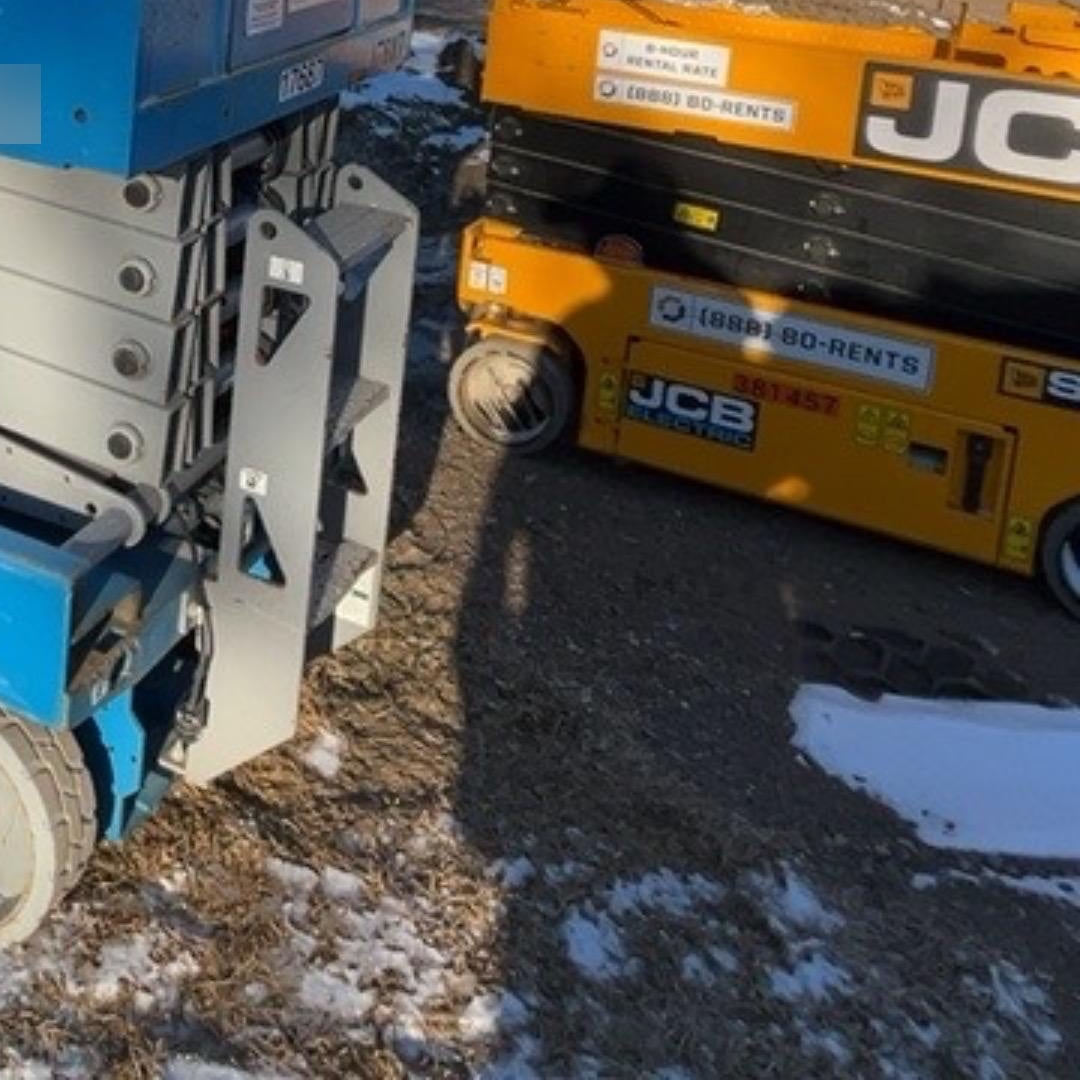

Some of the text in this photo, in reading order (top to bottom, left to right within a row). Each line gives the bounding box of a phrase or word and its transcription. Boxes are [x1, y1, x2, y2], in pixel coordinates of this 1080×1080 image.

[699, 307, 920, 376] (888) 80-RENTS
[629, 378, 754, 433] JCB
